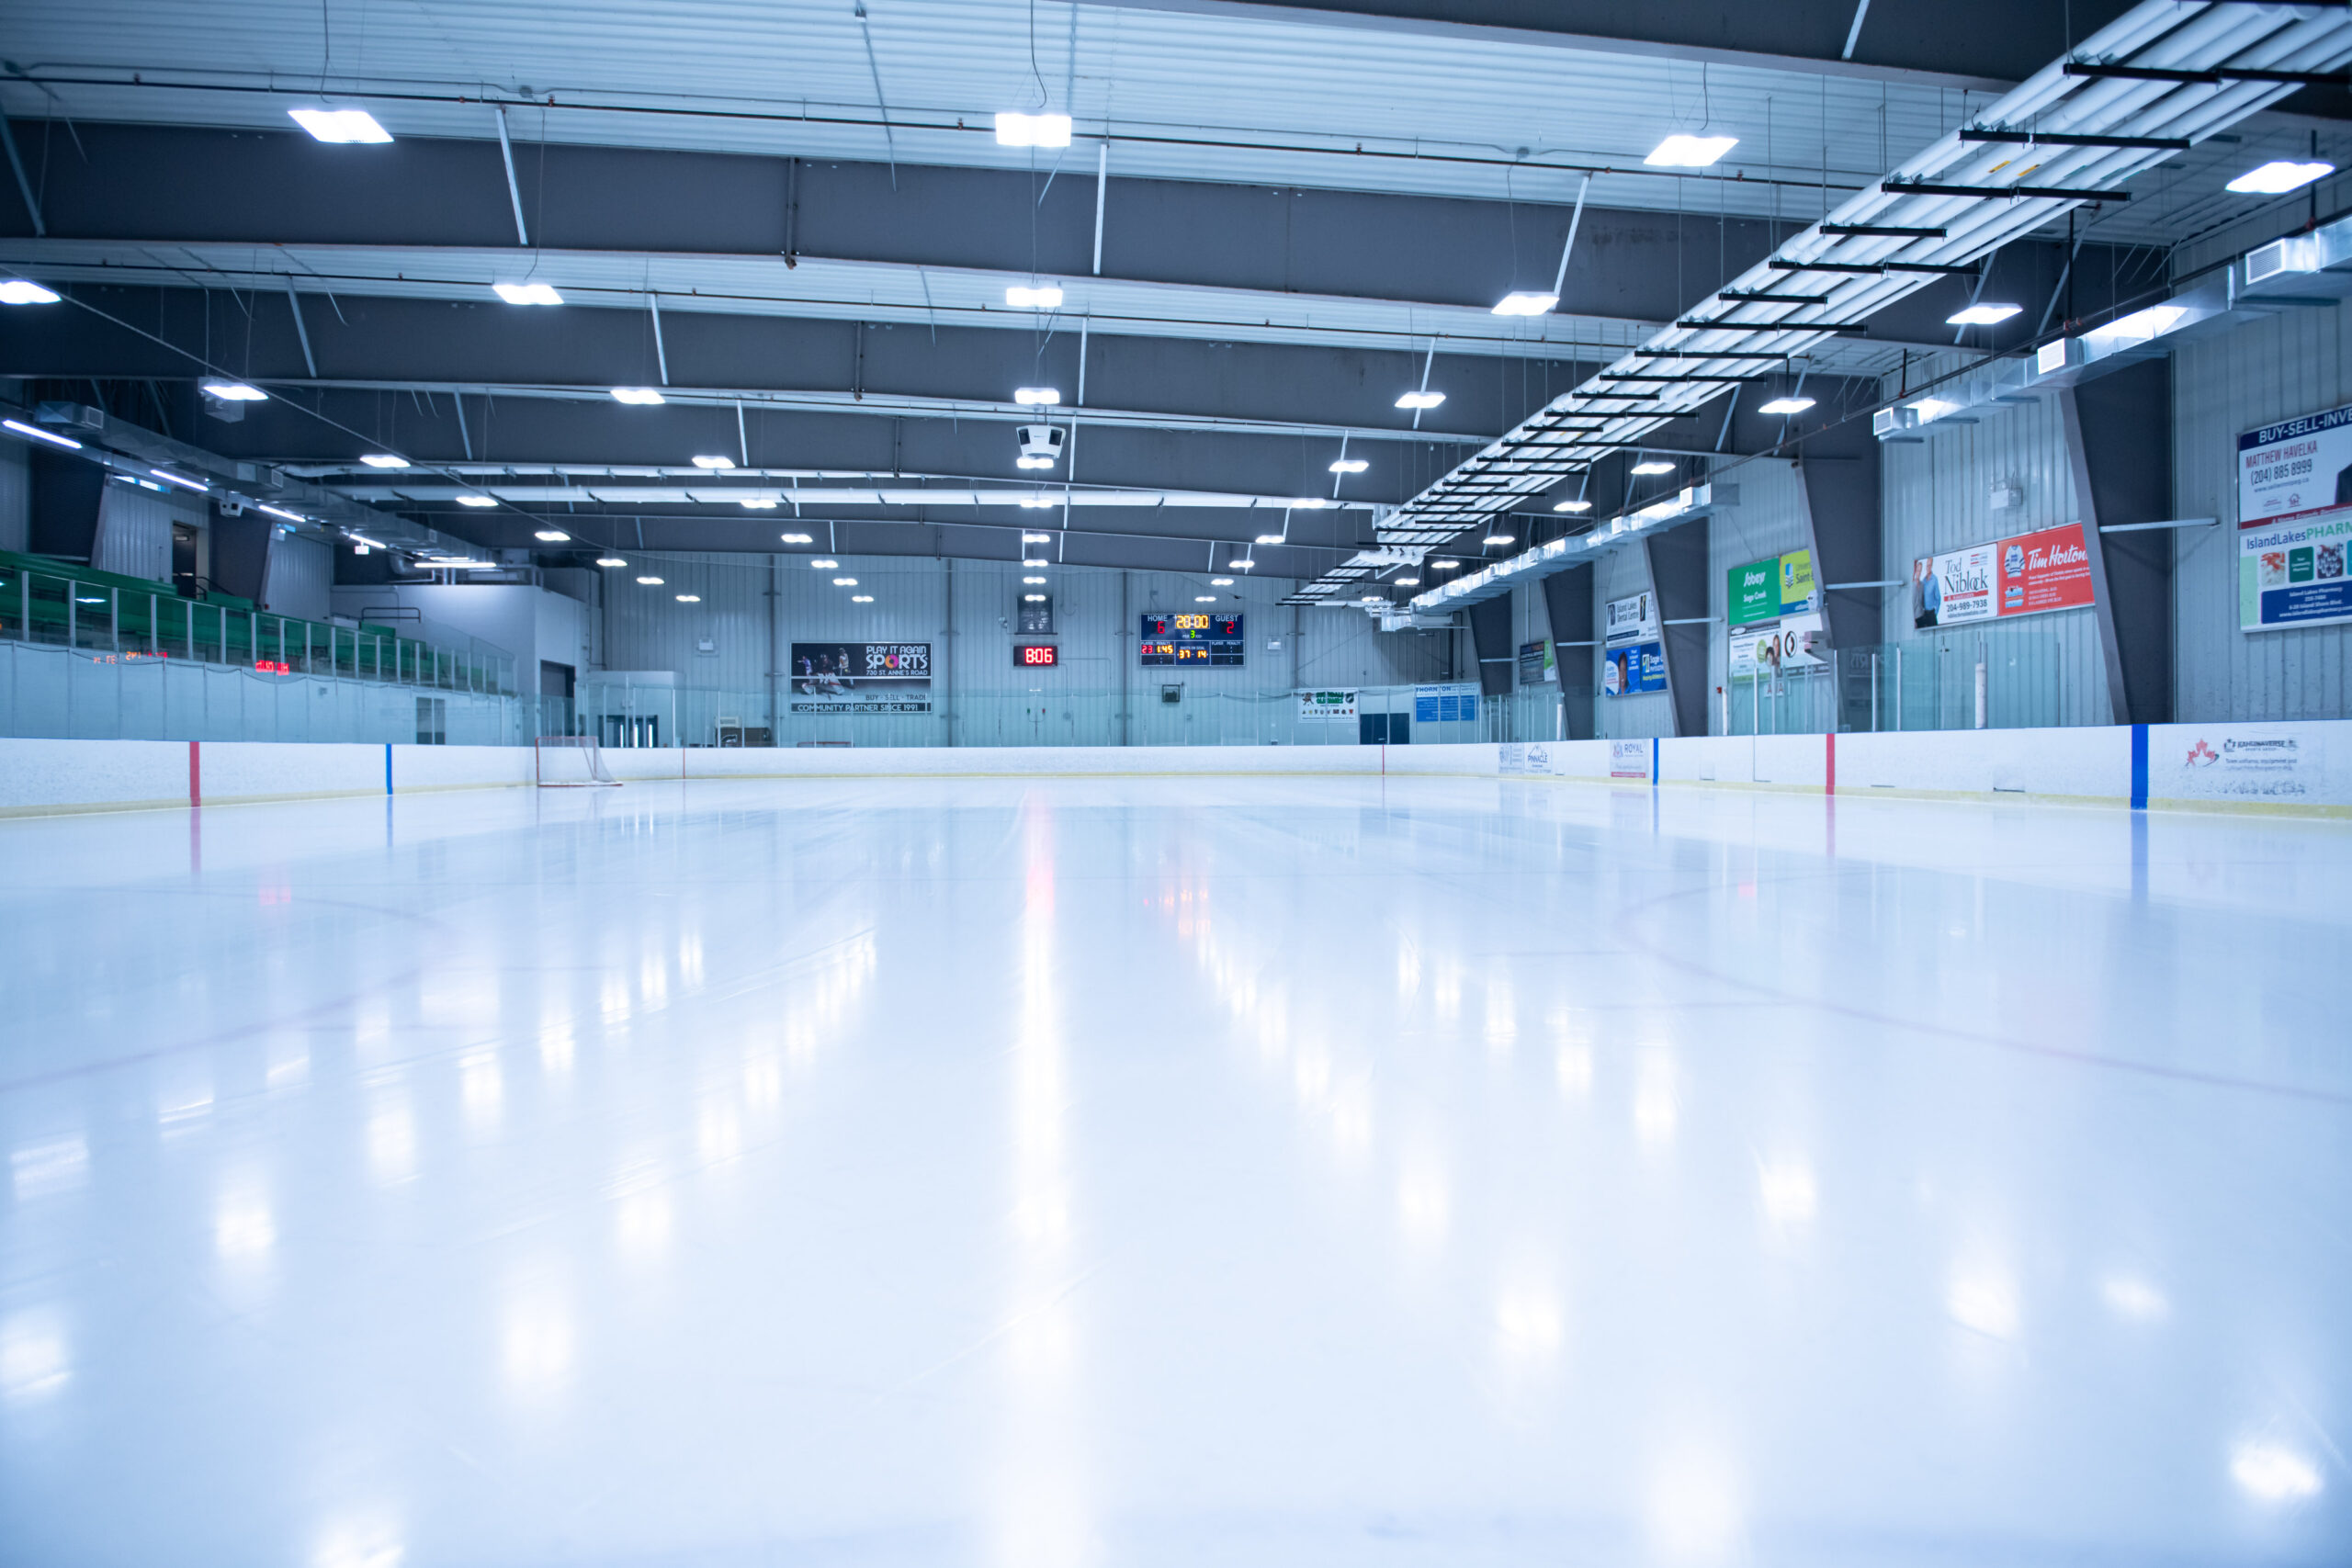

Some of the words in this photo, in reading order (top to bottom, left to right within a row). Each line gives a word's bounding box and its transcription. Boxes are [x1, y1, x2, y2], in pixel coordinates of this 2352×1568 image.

[2245, 449, 2281, 468] MATTHEW
[2283, 440, 2318, 459] HAVELKA
[2251, 467, 2271, 485] (204)
[2273, 463, 2289, 479] 885
[2290, 458, 2312, 476] 8999
[2028, 547, 2048, 570] Tim
[1945, 557, 1962, 574] Tod
[1945, 568, 1988, 594] Niblock
[1947, 599, 1987, 613] 204-989-7938
[1158, 621, 1165, 634] 6
[1227, 621, 1234, 634] 2
[1176, 615, 1209, 628] 20:00
[1191, 630, 1195, 638] 3
[866, 646, 888, 654] PLAY
[890, 646, 898, 654] IT
[899, 646, 926, 654] AGAIN
[1025, 648, 1053, 663] 8:06
[1141, 645, 1153, 654] 23
[1179, 650, 1191, 659] 37
[865, 654, 928, 669] SPORTS
[1624, 743, 1644, 753] ROYAL
[1527, 752, 1548, 763] PINNACLE
